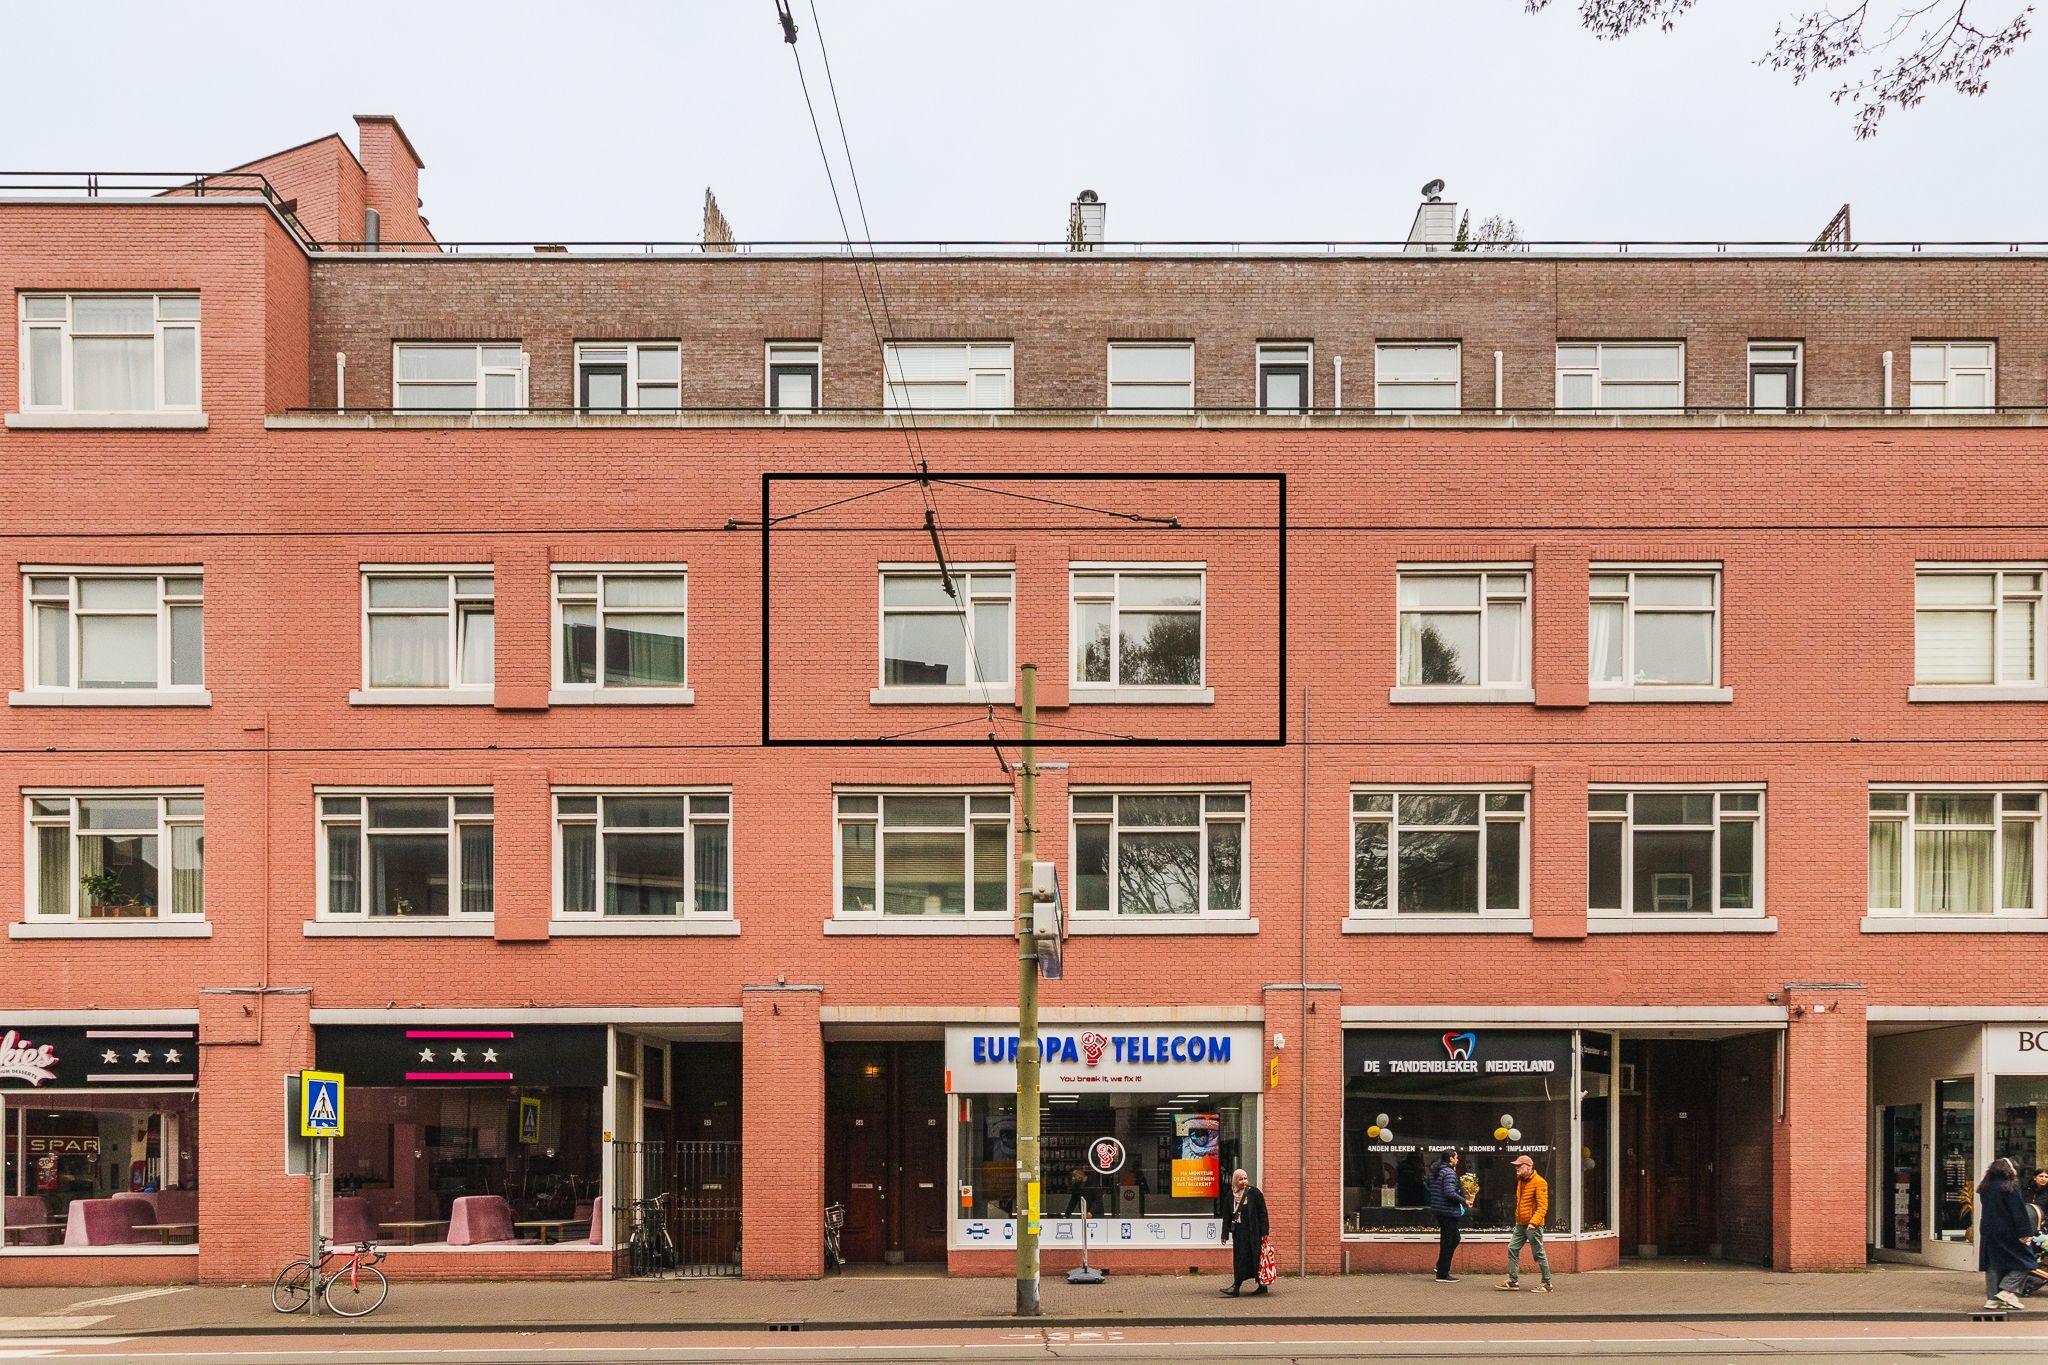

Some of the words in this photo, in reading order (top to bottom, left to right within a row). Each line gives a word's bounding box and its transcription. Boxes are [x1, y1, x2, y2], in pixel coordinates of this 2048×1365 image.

[0, 1030, 59, 1068] kies
[973, 1036, 1079, 1063] EURPA
[1112, 1036, 1231, 1063] TELECOM
[1364, 1060, 1380, 1073] DE
[1389, 1060, 1478, 1073] TANDENBLEKER
[1486, 1060, 1555, 1073] NEDERLAND
[31, 1139, 98, 1151] SPAR
